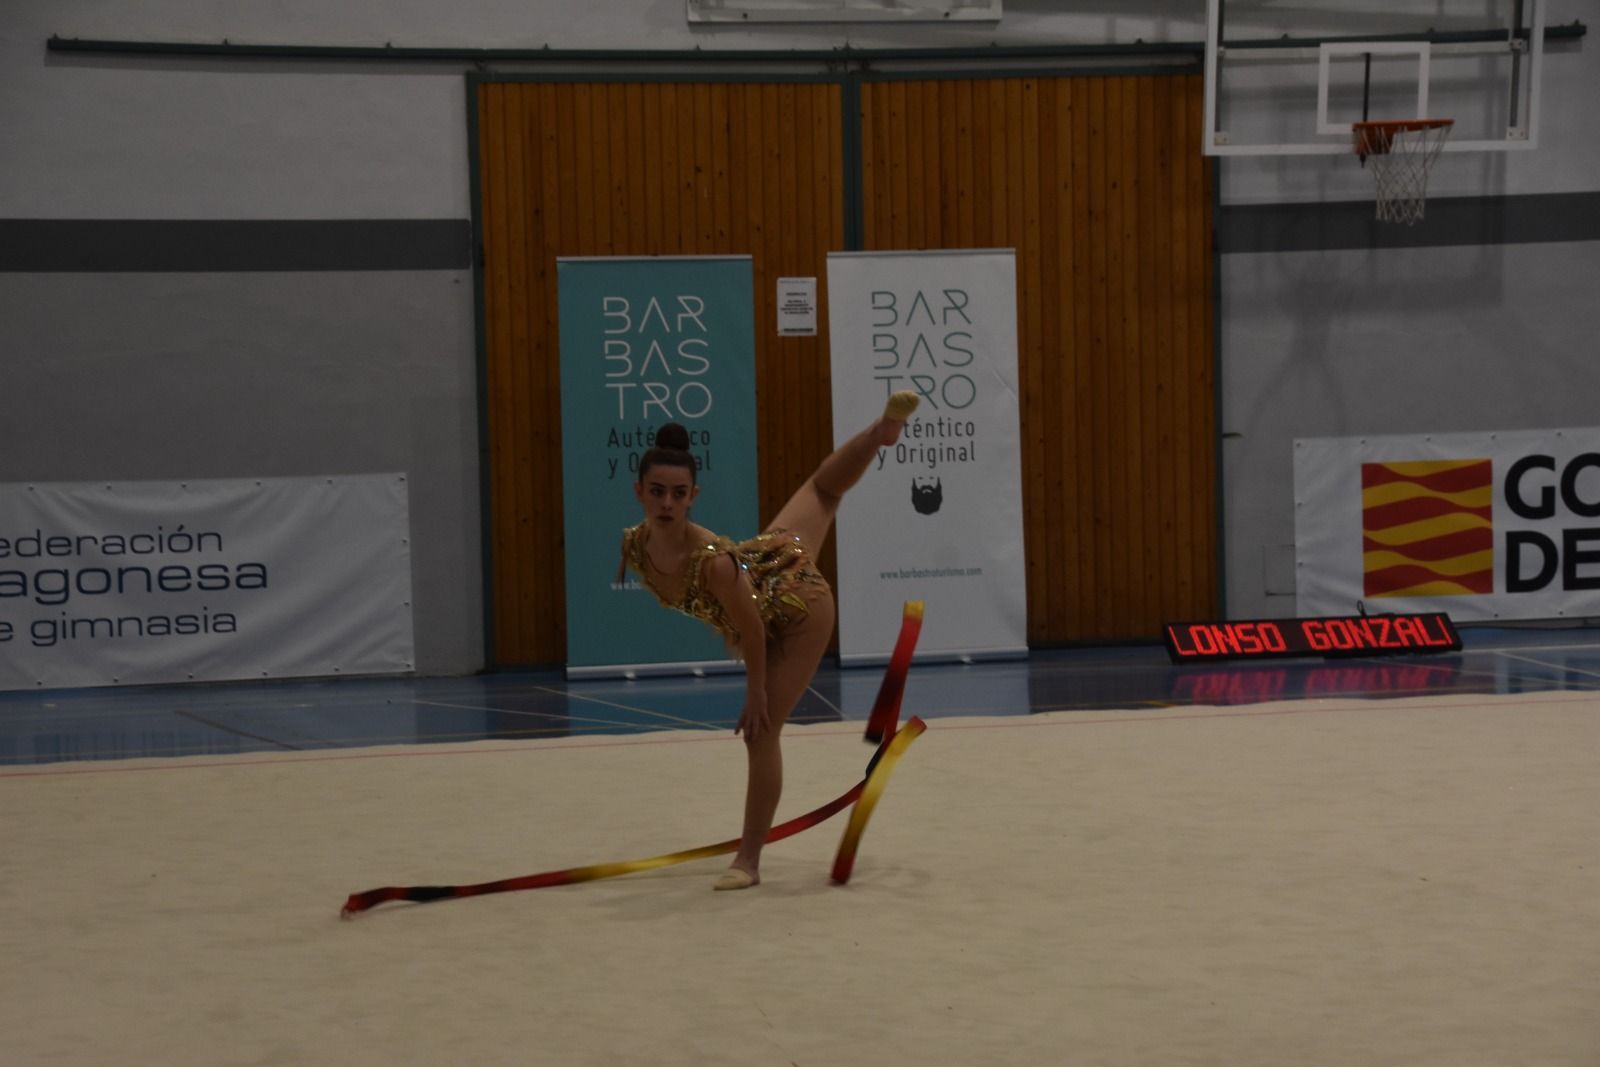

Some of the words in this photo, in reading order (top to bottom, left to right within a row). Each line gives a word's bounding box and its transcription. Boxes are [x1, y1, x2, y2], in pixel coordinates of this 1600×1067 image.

[602, 295, 708, 335] BAR
[871, 288, 972, 327] BAR
[604, 338, 710, 377] BAS
[872, 331, 974, 370] BAS
[605, 381, 713, 420] TRO
[873, 373, 976, 410] TRO
[607, 424, 711, 448] Autéco
[903, 416, 975, 439] téntico
[608, 457, 618, 480] y
[876, 449, 887, 471] y
[896, 440, 976, 469] Original
[1504, 452, 1600, 520] GO
[1505, 527, 1600, 594] DE
[0, 561, 268, 606] agonesa
[30, 606, 238, 647] gimnasia
[1168, 622, 1288, 656] LONSO
